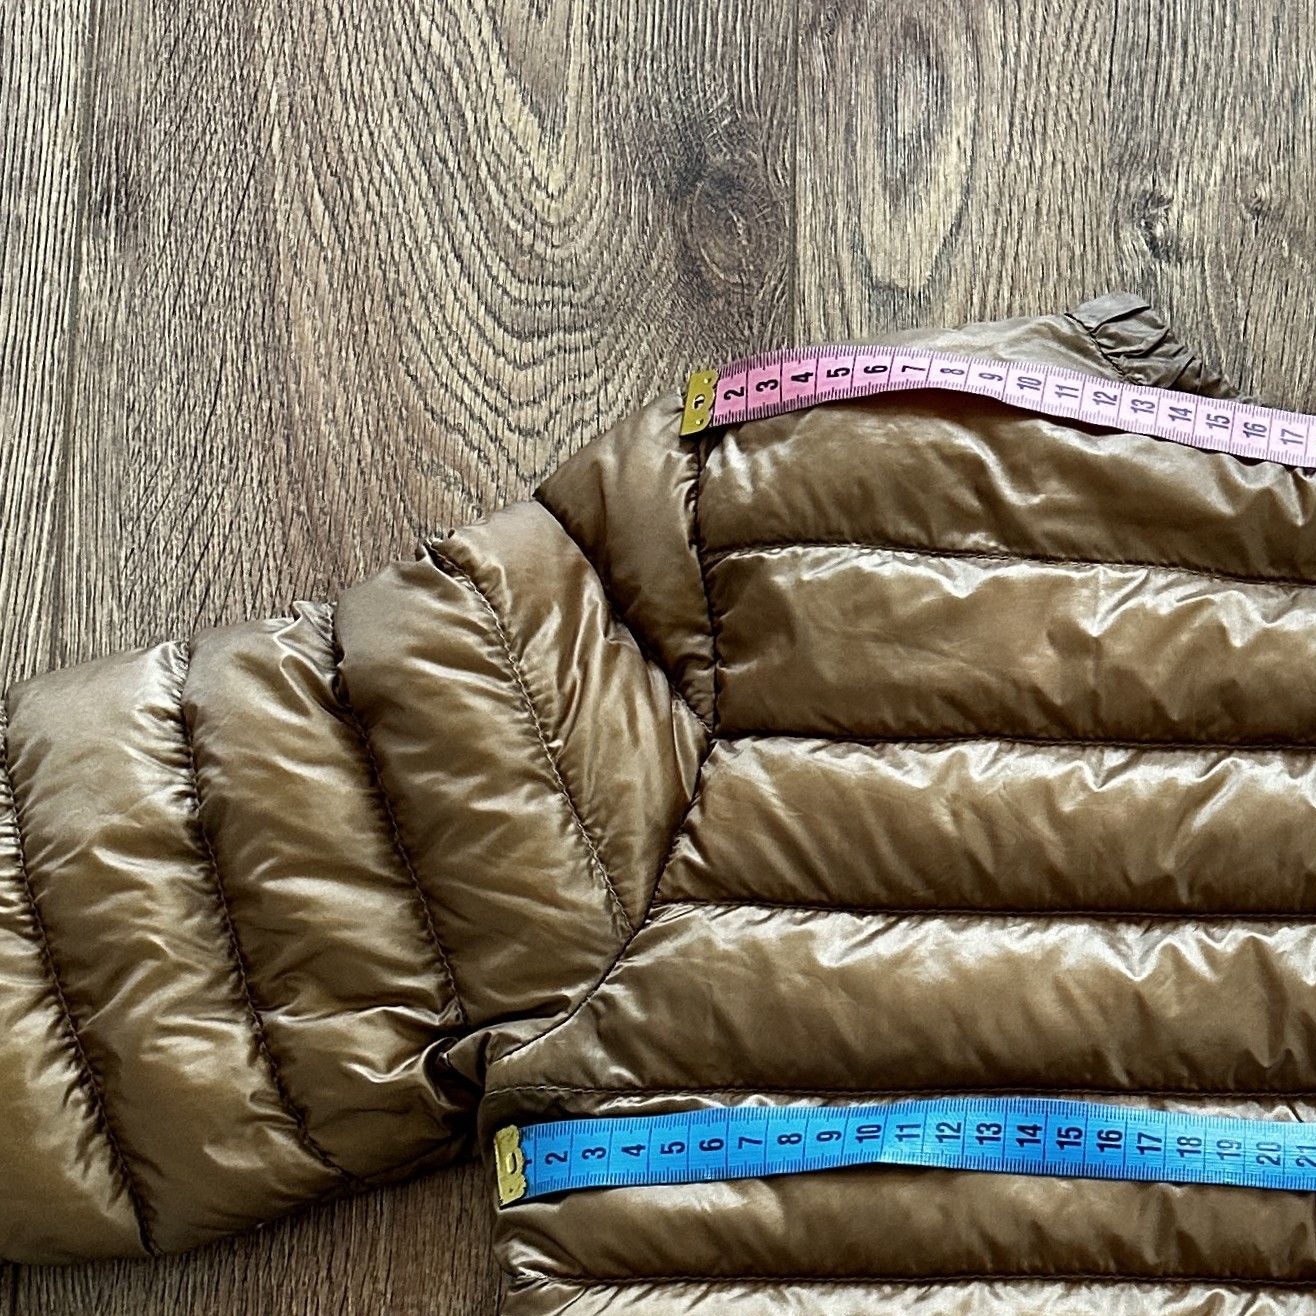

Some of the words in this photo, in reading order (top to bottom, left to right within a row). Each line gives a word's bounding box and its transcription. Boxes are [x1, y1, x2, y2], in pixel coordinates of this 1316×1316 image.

[790, 371, 814, 383] 4
[825, 367, 851, 379] 5
[863, 365, 889, 375] 6
[755, 379, 779, 393] 3
[1015, 375, 1043, 392] 10
[723, 385, 745, 401] 2
[1167, 405, 1193, 423] 14
[1279, 427, 1305, 446] 17
[776, 1132, 803, 1146] 8
[854, 1124, 883, 1144] 10
[934, 1121, 962, 1144] 12
[974, 1122, 1003, 1146] 13
[1015, 1123, 1043, 1148] 14
[1055, 1126, 1083, 1151] 15
[1095, 1129, 1123, 1153] 16
[621, 1143, 646, 1157] 4
[698, 1137, 725, 1152] 6
[1135, 1131, 1163, 1156] 17
[544, 1151, 569, 1165] 2
